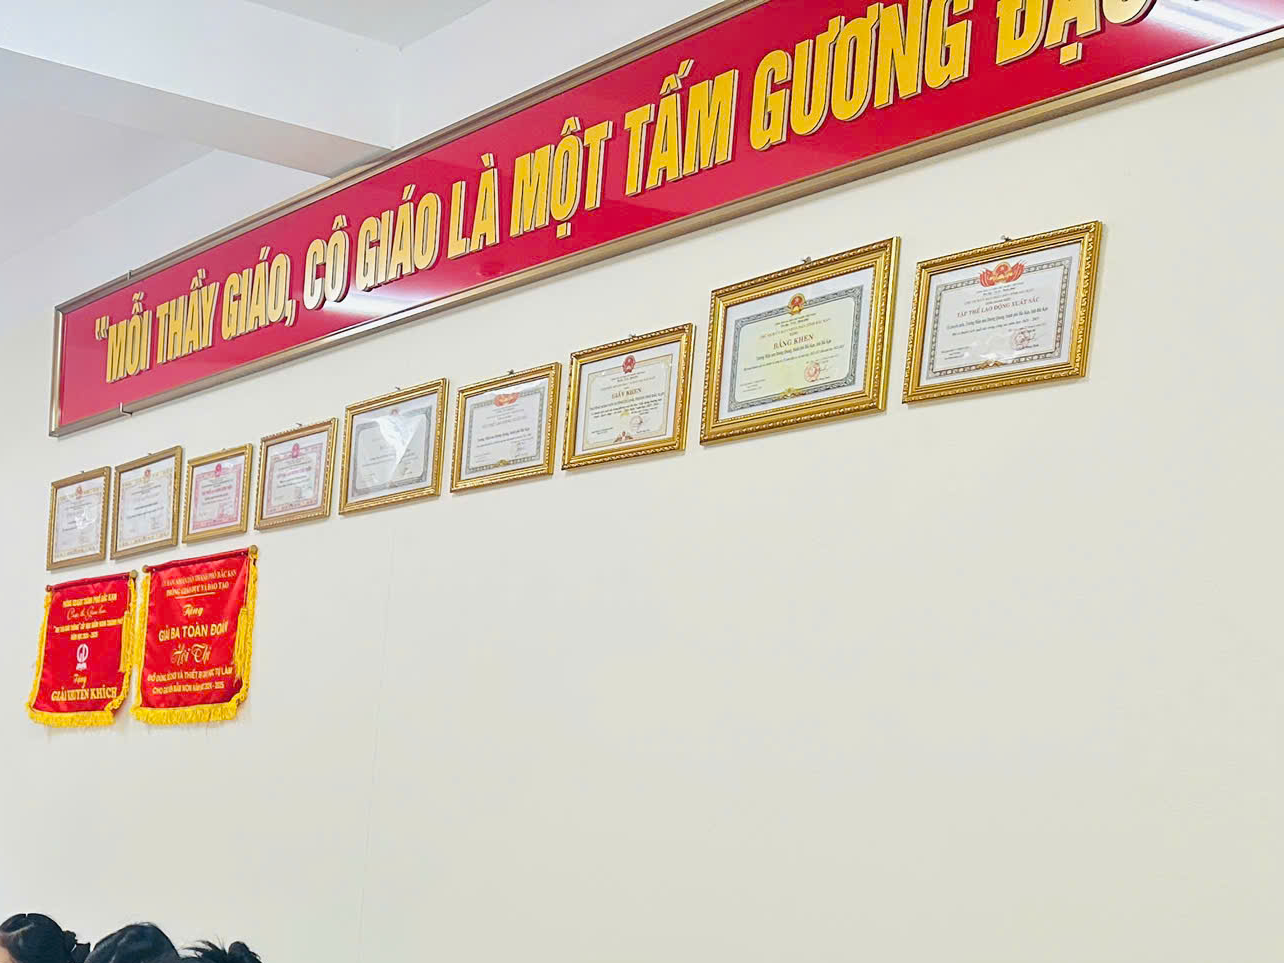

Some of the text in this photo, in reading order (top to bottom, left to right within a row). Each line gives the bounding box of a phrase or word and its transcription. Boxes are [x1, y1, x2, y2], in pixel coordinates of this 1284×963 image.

[156, 267, 220, 366] THẦY
[221, 245, 296, 341] GIÁO,
[303, 213, 350, 311] CÔ
[354, 184, 443, 292] GIÁO
[447, 153, 500, 260] LÀ
[510, 117, 613, 239] MỘT
[624, 58, 740, 197] TẤM
[750, 0, 972, 151] GƯƠNG
